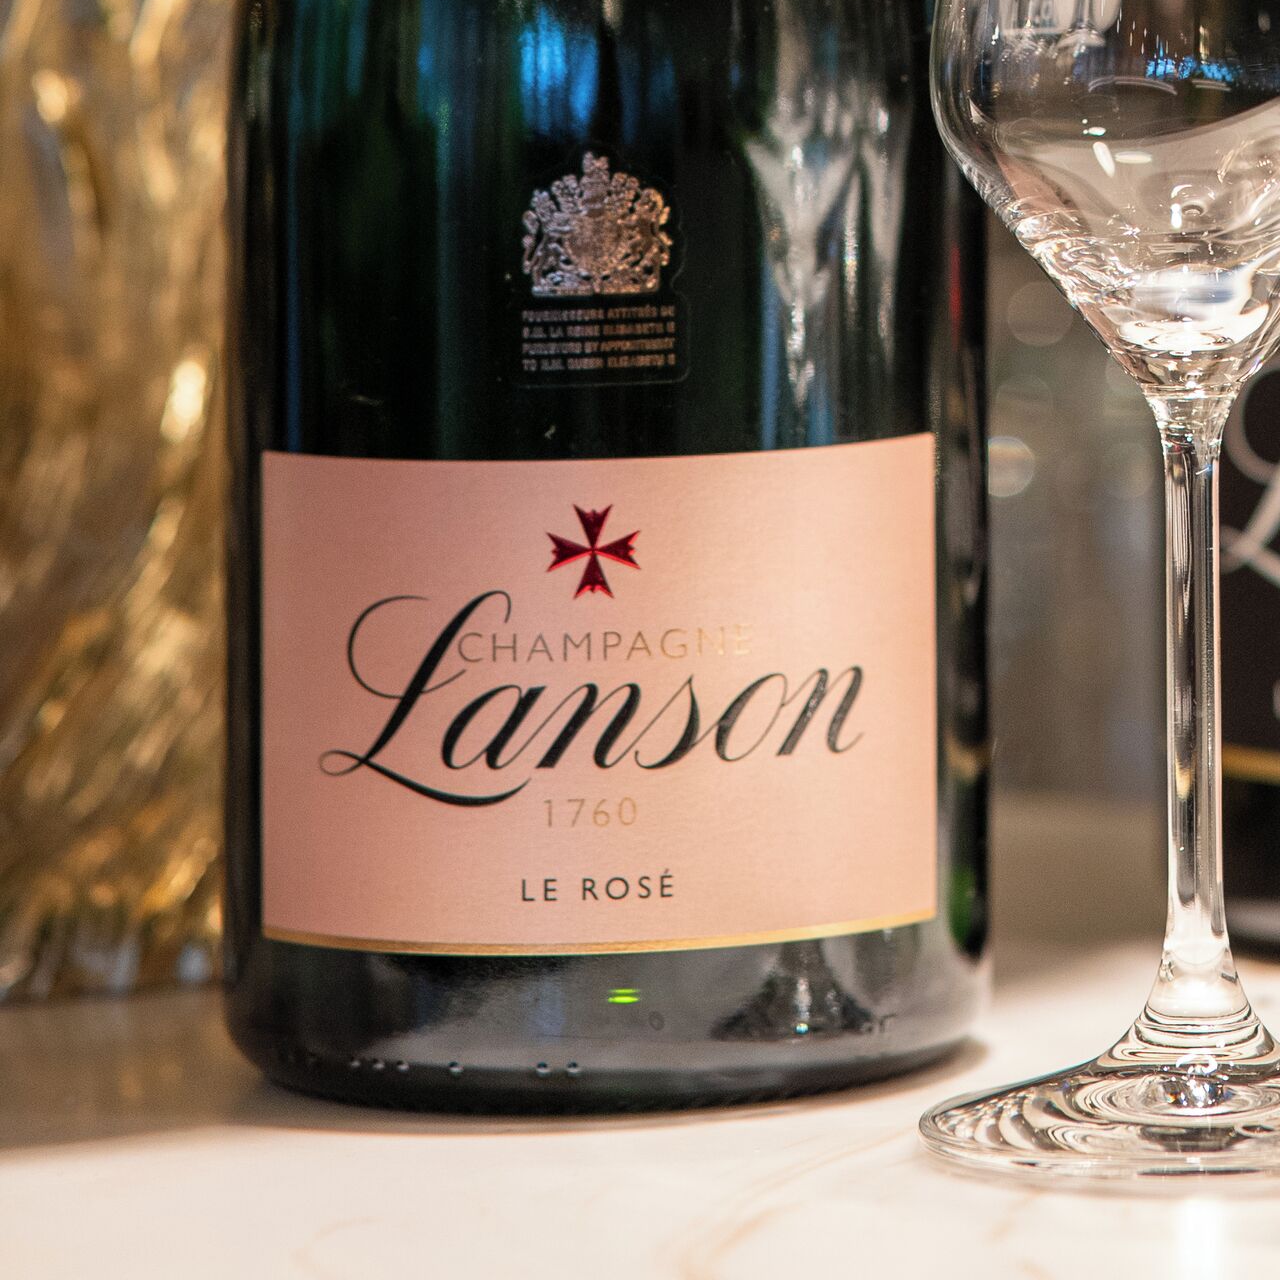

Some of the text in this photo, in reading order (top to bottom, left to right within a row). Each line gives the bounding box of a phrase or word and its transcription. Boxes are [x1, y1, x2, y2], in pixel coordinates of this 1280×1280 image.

[457, 622, 752, 665] CHAMPAGNE
[318, 590, 865, 807] Lanson
[543, 797, 639, 828] 1760
[521, 868, 675, 903] LE ROSÉ
